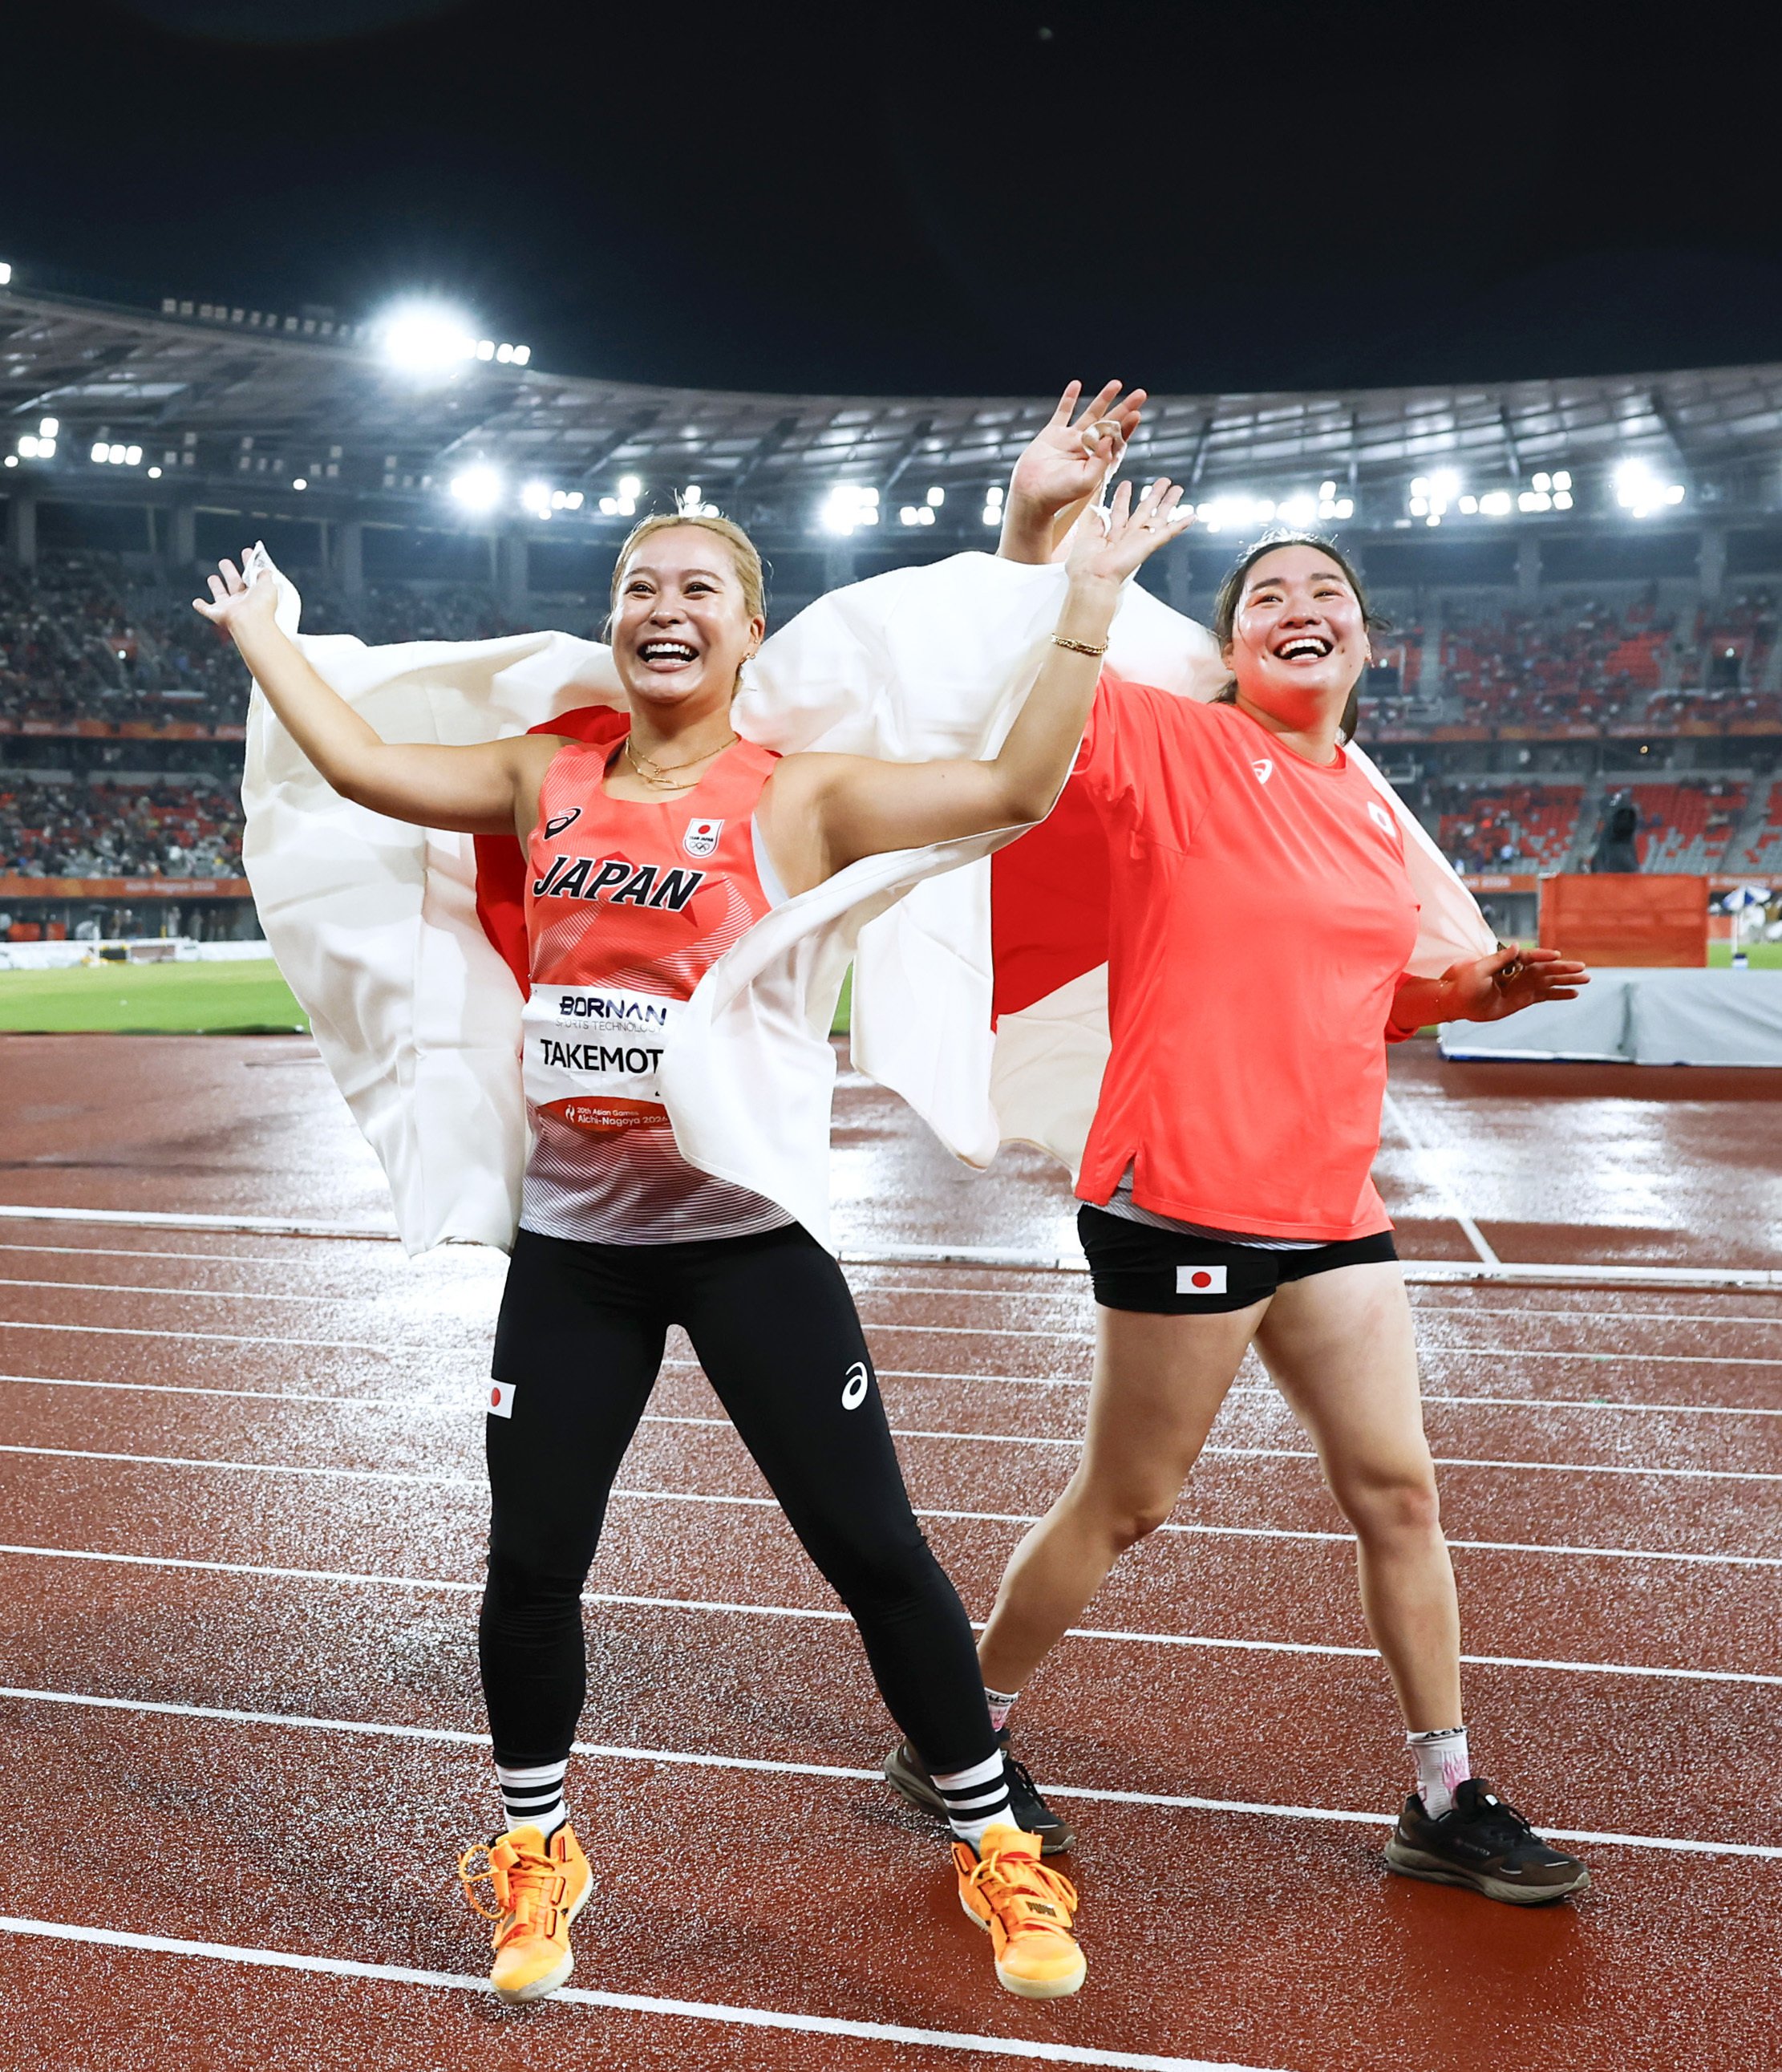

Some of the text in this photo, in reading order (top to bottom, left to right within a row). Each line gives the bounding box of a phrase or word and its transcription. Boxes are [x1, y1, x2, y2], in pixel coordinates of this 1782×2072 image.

[533, 855, 704, 911] JAPAN
[559, 995, 667, 1026] BORNAN
[556, 1018, 662, 1033] SPORTS TECHNOLOGY
[540, 1038, 664, 1074] TAKEMOT
[577, 1107, 592, 1115] 20th
[593, 1108, 611, 1116] Asian
[577, 1114, 668, 1127] Aichi-Nagoya 2026
